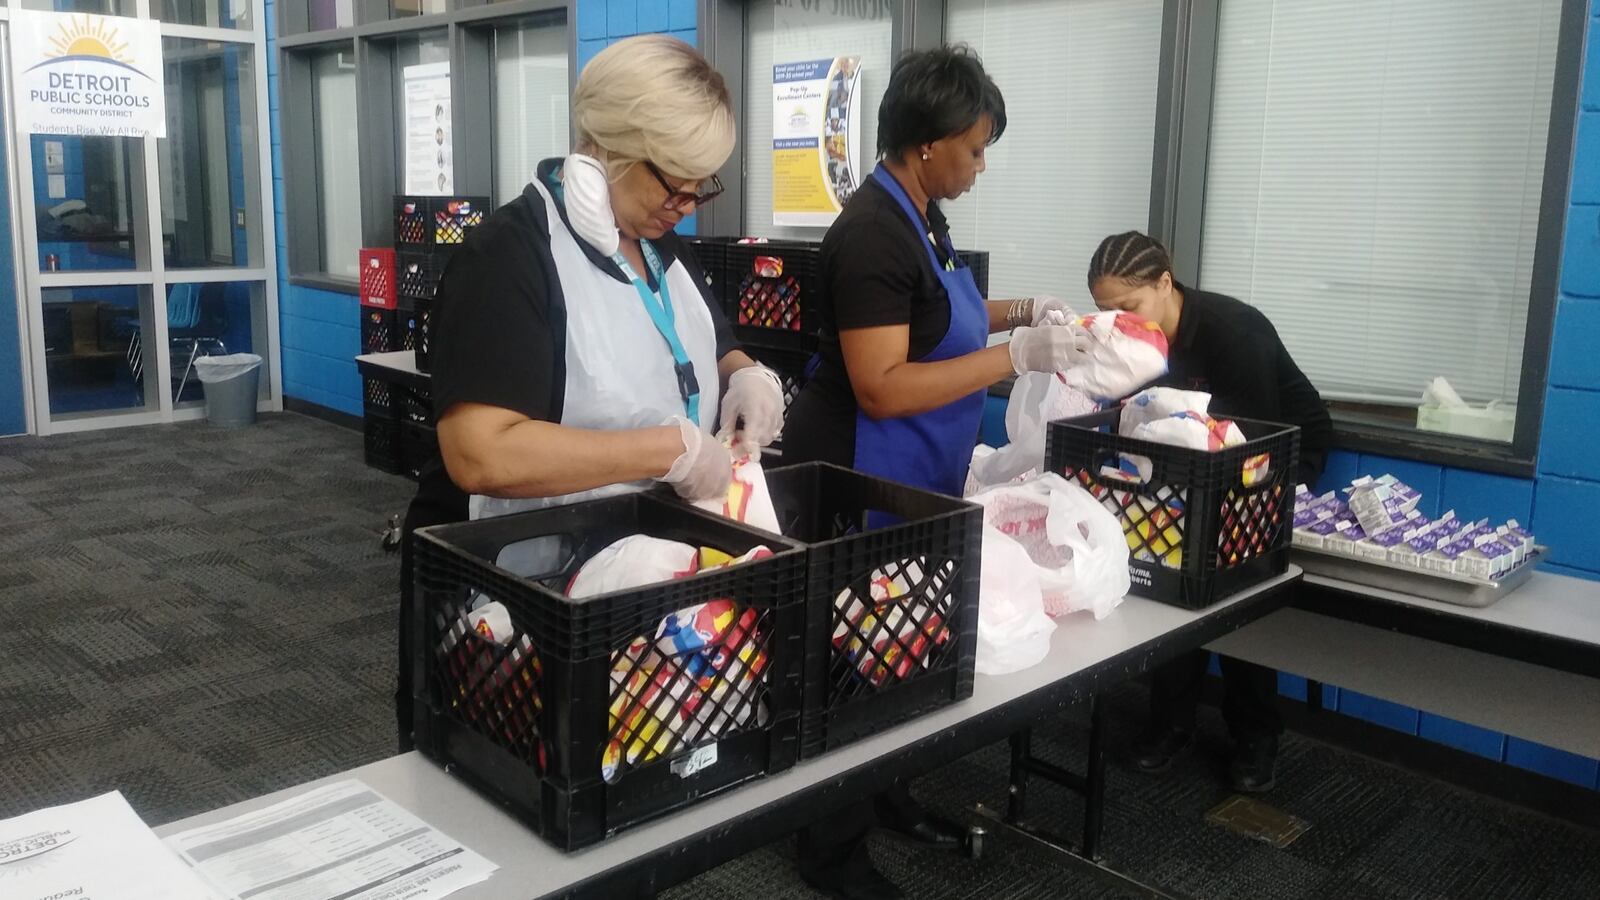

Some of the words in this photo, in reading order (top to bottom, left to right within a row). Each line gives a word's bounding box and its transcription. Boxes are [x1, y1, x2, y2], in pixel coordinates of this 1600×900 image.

[49, 72, 131, 93] DETROIT
[31, 90, 81, 104] PUBLIC
[85, 94, 150, 107] SCHOOLS
[50, 107, 98, 116] COMMUNITY
[100, 109, 133, 118] DISTRICT
[32, 122, 75, 134] Students
[99, 126, 116, 136] We
[117, 126, 129, 136] All
[0, 838, 58, 859] DETRO
